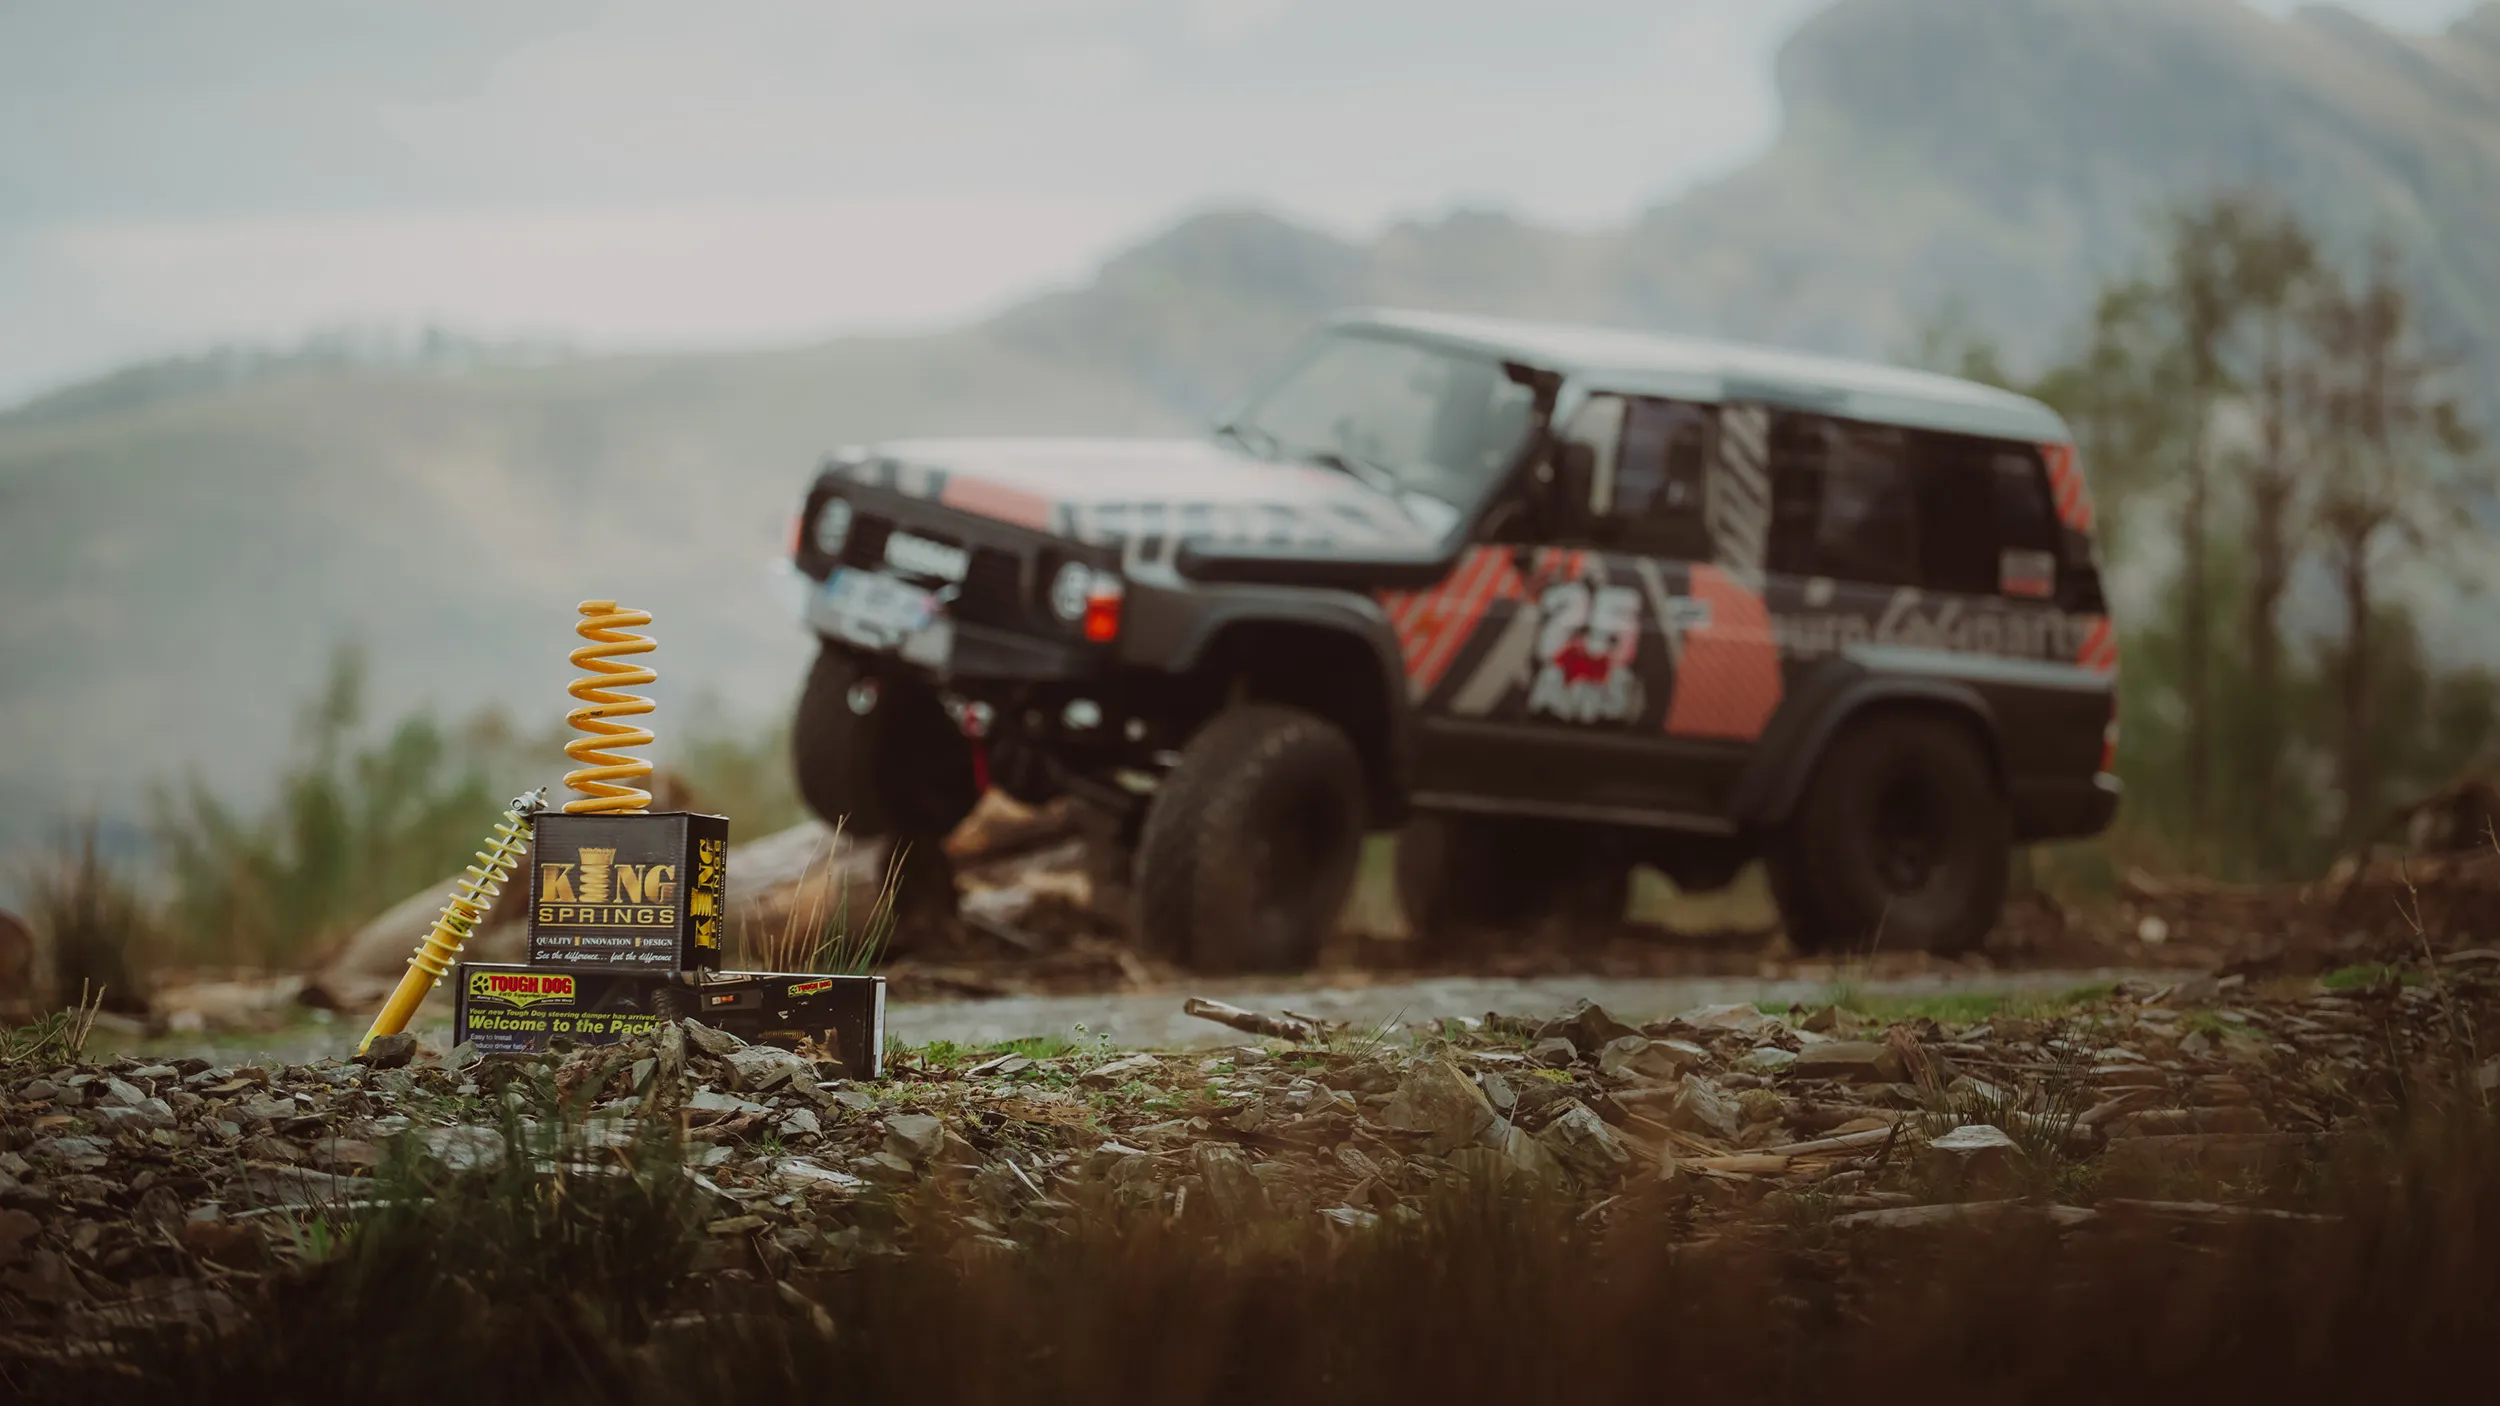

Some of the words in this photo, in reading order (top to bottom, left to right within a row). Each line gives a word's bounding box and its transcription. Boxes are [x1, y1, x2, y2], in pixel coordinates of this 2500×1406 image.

[539, 848, 677, 904] KING
[690, 838, 714, 948] KING
[709, 840, 721, 949] SPRINGS
[538, 908, 675, 924] SPRINGS
[536, 937, 573, 946] QUALITY
[582, 938, 632, 946] INNOVATION
[643, 938, 673, 947] DESIGN
[535, 950, 550, 960] See
[551, 951, 563, 960] the
[610, 951, 624, 963] feel
[625, 951, 637, 961] the
[639, 951, 673, 963] difference
[489, 975, 539, 993] TOUGH
[541, 977, 572, 994] DOG
[797, 983, 819, 992] TOUGH
[819, 980, 831, 988] DOG
[469, 1007, 486, 1015] Your
[506, 1009, 529, 1017] Tough
[531, 1010, 546, 1018] Dog
[548, 1011, 580, 1020] steering
[581, 1012, 611, 1020] damper
[469, 1015, 548, 1031] Welcome
[553, 1019, 570, 1032] to
[576, 1019, 604, 1034] the
[470, 1033, 486, 1041] Easy
